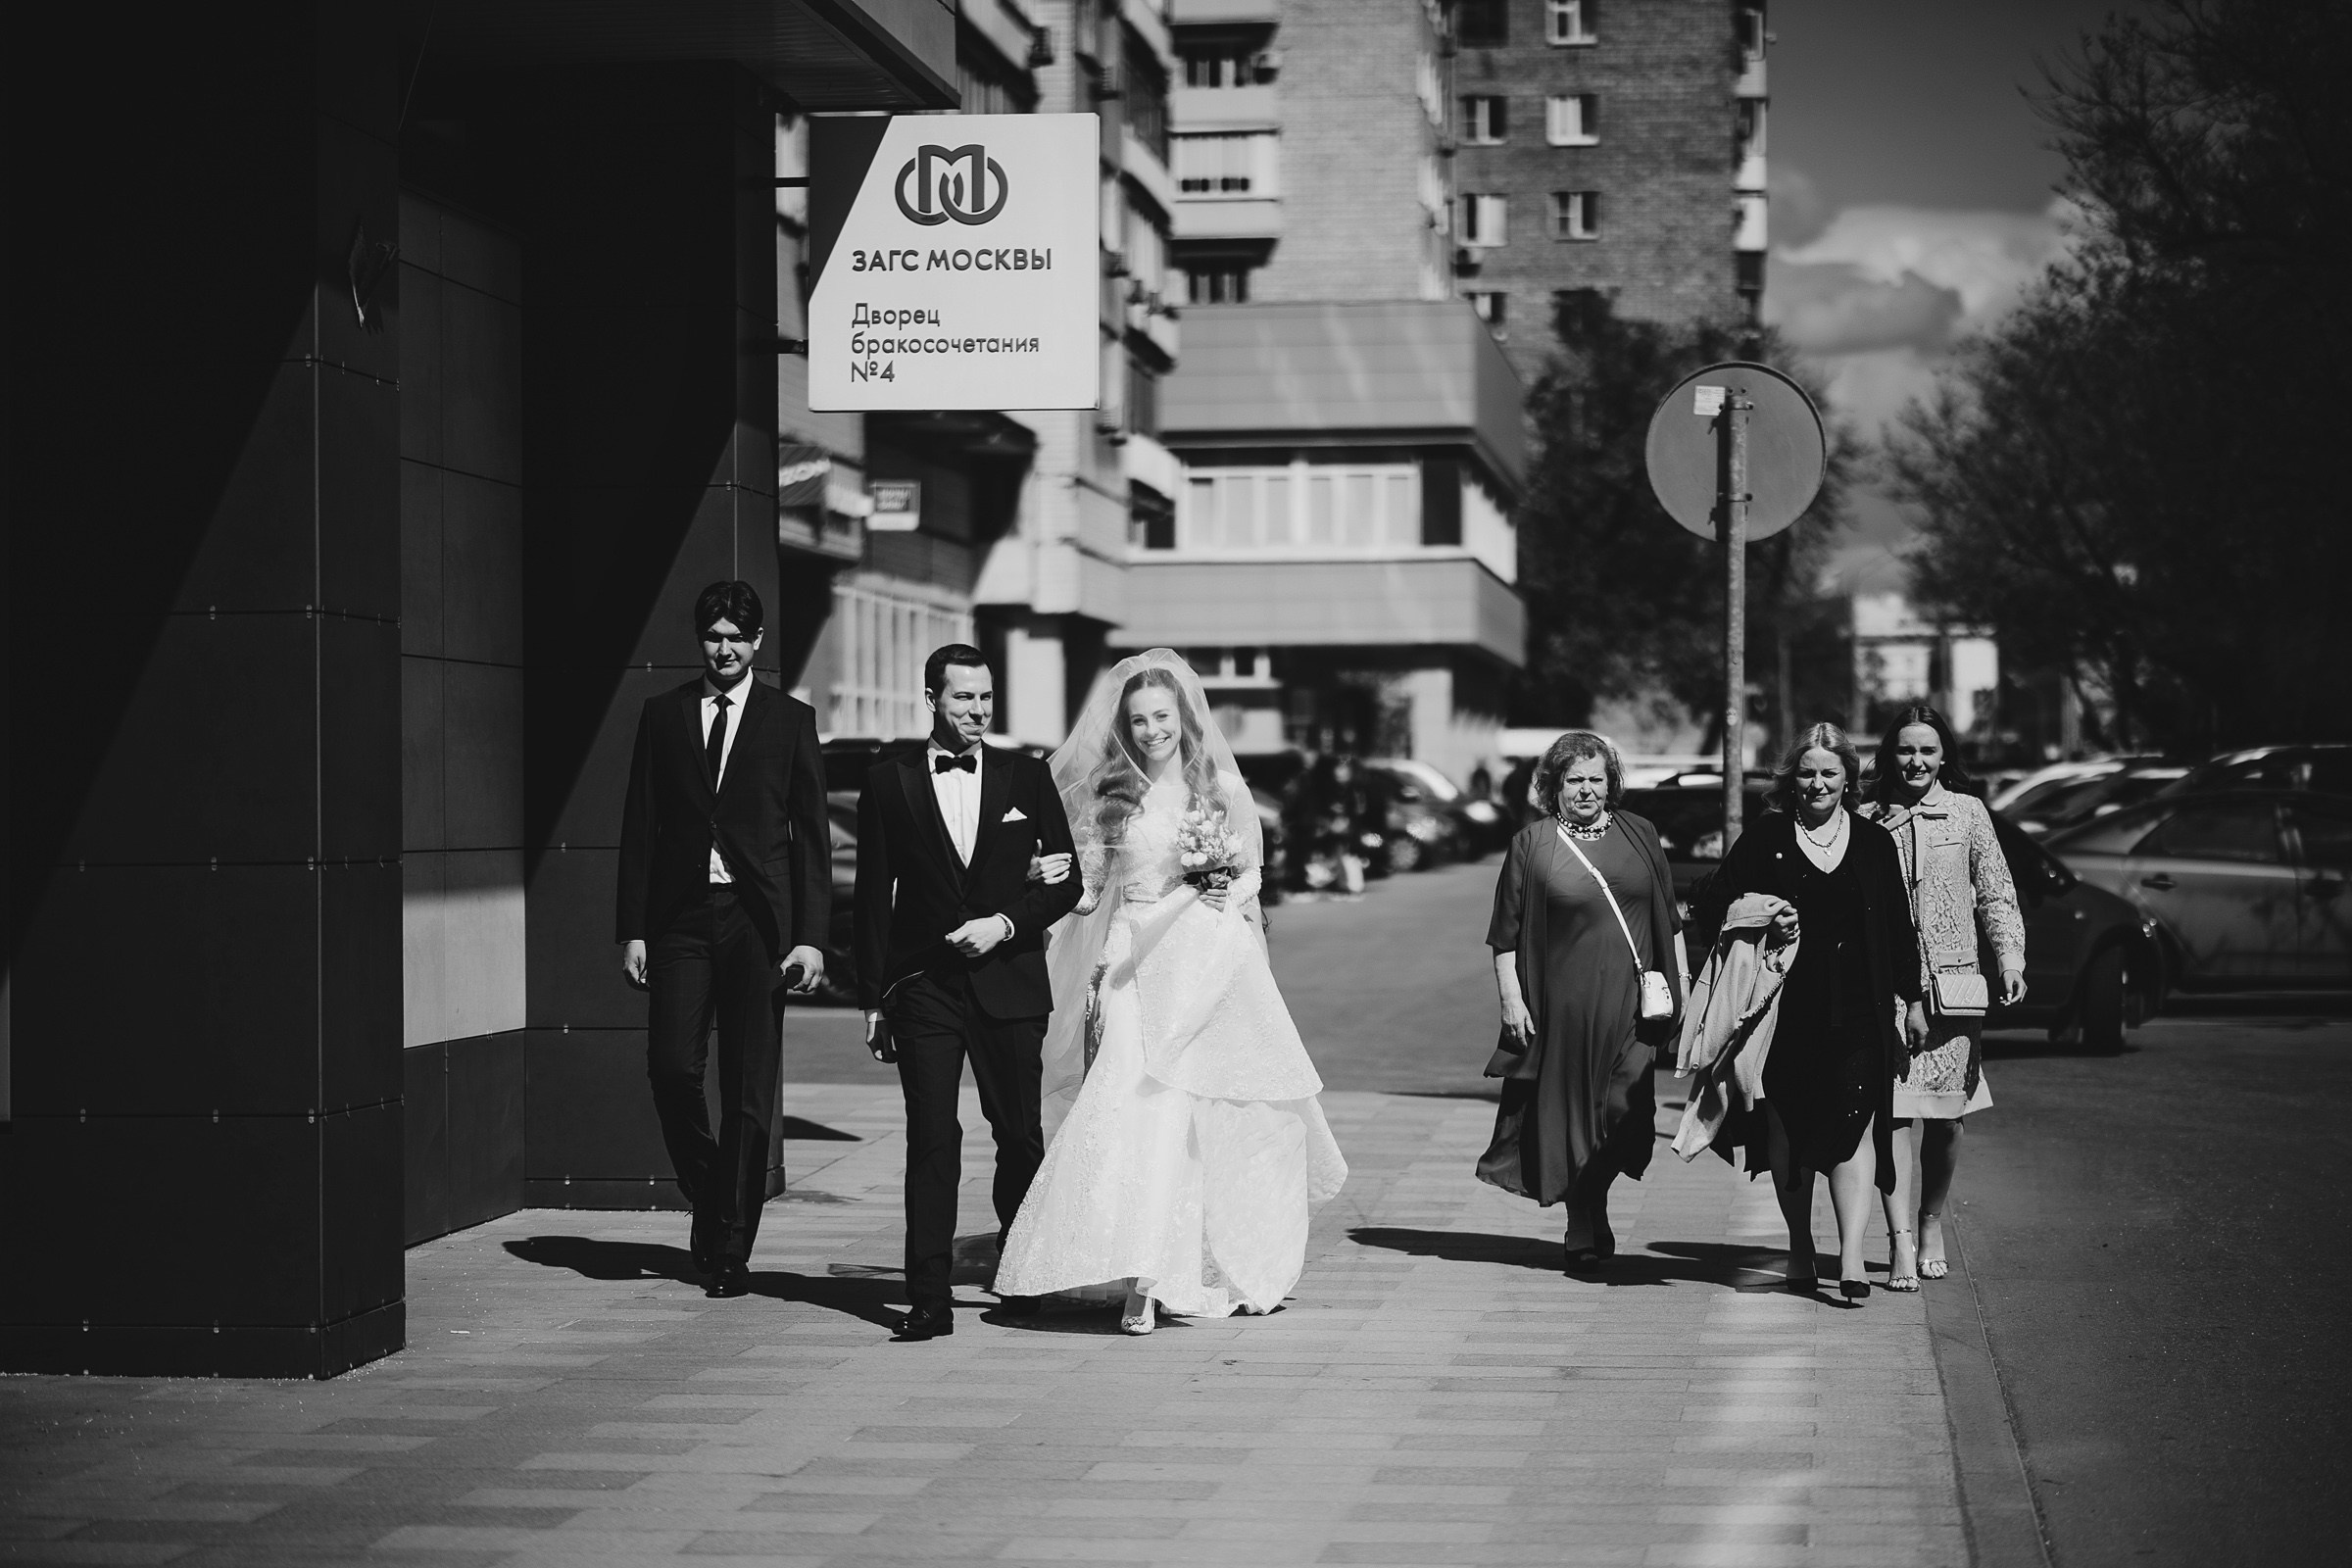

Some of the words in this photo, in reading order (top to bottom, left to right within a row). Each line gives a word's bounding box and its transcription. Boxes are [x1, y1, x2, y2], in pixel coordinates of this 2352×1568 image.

[852, 249, 919, 272] ЗАГС
[926, 248, 1052, 271] МОСКВЫ
[852, 302, 941, 330] Дворец
[852, 330, 1040, 360] бракосочетания
[851, 360, 896, 383] №4
